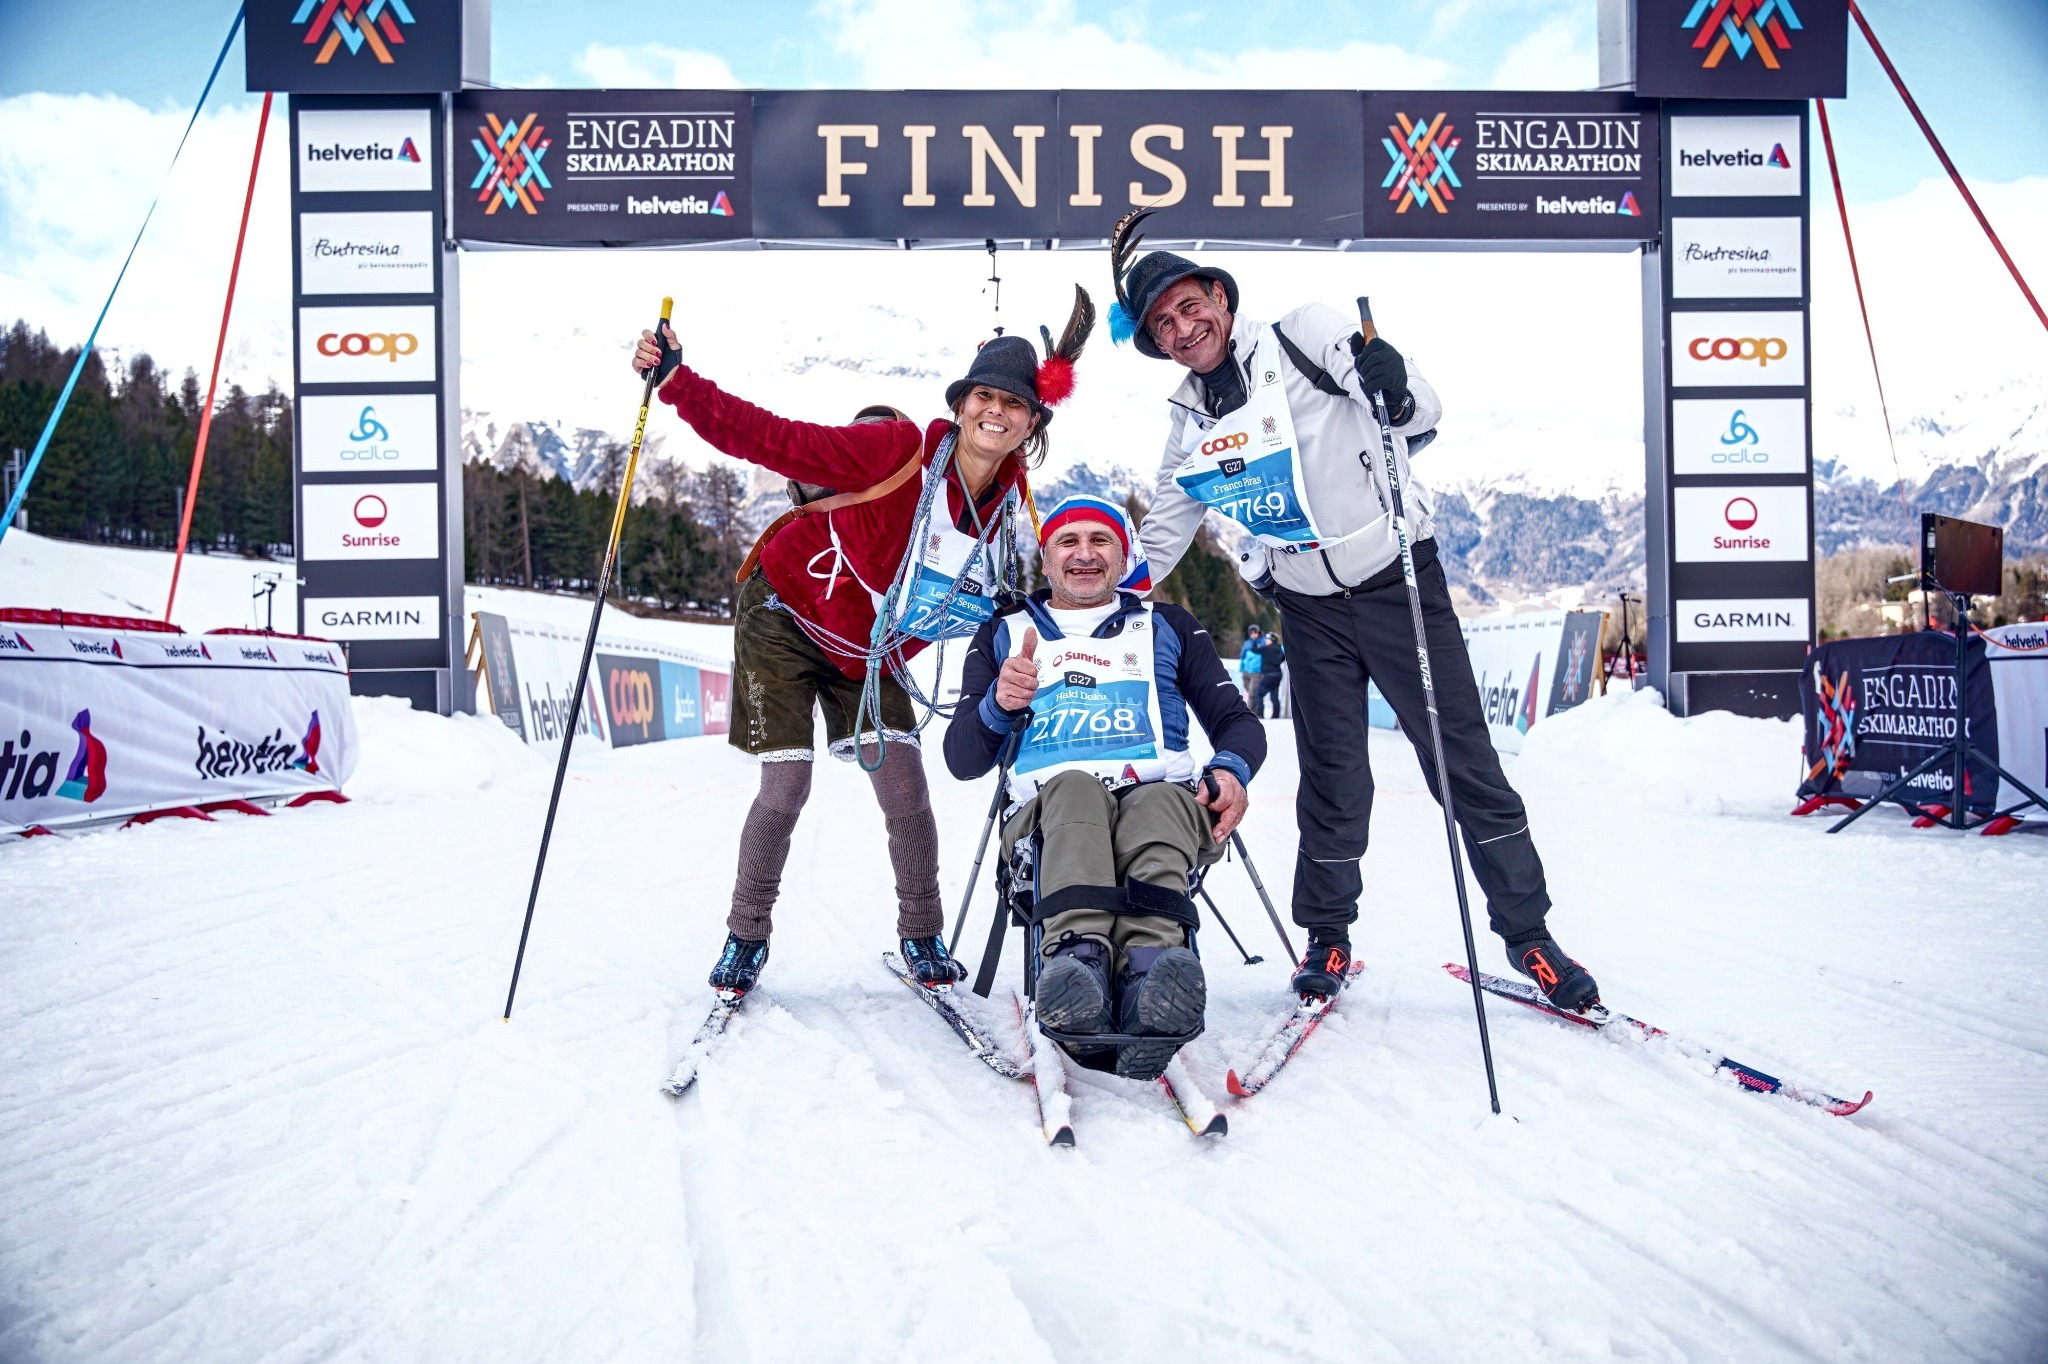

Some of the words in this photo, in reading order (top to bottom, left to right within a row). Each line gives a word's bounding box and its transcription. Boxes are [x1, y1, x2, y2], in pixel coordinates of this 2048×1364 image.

[567, 120, 735, 149] ENGADIN
[1476, 120, 1641, 149] ENGADIN
[308, 143, 393, 161] helvetia
[1680, 149, 1763, 167] helvetia
[567, 153, 735, 172] SKIMARATHON
[817, 124, 1293, 208] FINISH
[1476, 154, 1641, 172] SKIMARATHON
[567, 203, 609, 212] PRESENTED
[610, 203, 619, 212] BY
[627, 195, 709, 214] helvetia
[1477, 203, 1518, 211] PRESENTED
[1519, 203, 1528, 211] BY
[1537, 196, 1616, 214] helvetia
[314, 237, 401, 257] Pontresina
[1685, 243, 1770, 261] Pontresina
[317, 333, 418, 362] coop
[1688, 337, 1787, 367] coop
[1201, 431, 1249, 456] coop
[340, 445, 399, 461] odlo
[1711, 448, 1769, 463] odlo
[1224, 460, 1242, 473] G27
[1213, 480, 1243, 495] Franco
[1212, 492, 1285, 522] 7769
[342, 533, 400, 547] Sunrise
[1713, 536, 1770, 549] Sunrise
[961, 580, 980, 594] G27
[321, 610, 421, 626] GARMIN
[1694, 612, 1791, 628] GARMIN
[69, 638, 110, 655] helvetia
[2004, 634, 2044, 649] helvetia
[162, 644, 200, 658] helvetia
[1065, 651, 1111, 667] Sunrise
[1068, 674, 1092, 686] G27
[609, 667, 654, 739] coop
[1477, 669, 1519, 726] lvetia
[1031, 708, 1136, 743] 27768
[195, 725, 297, 780] helvetia
